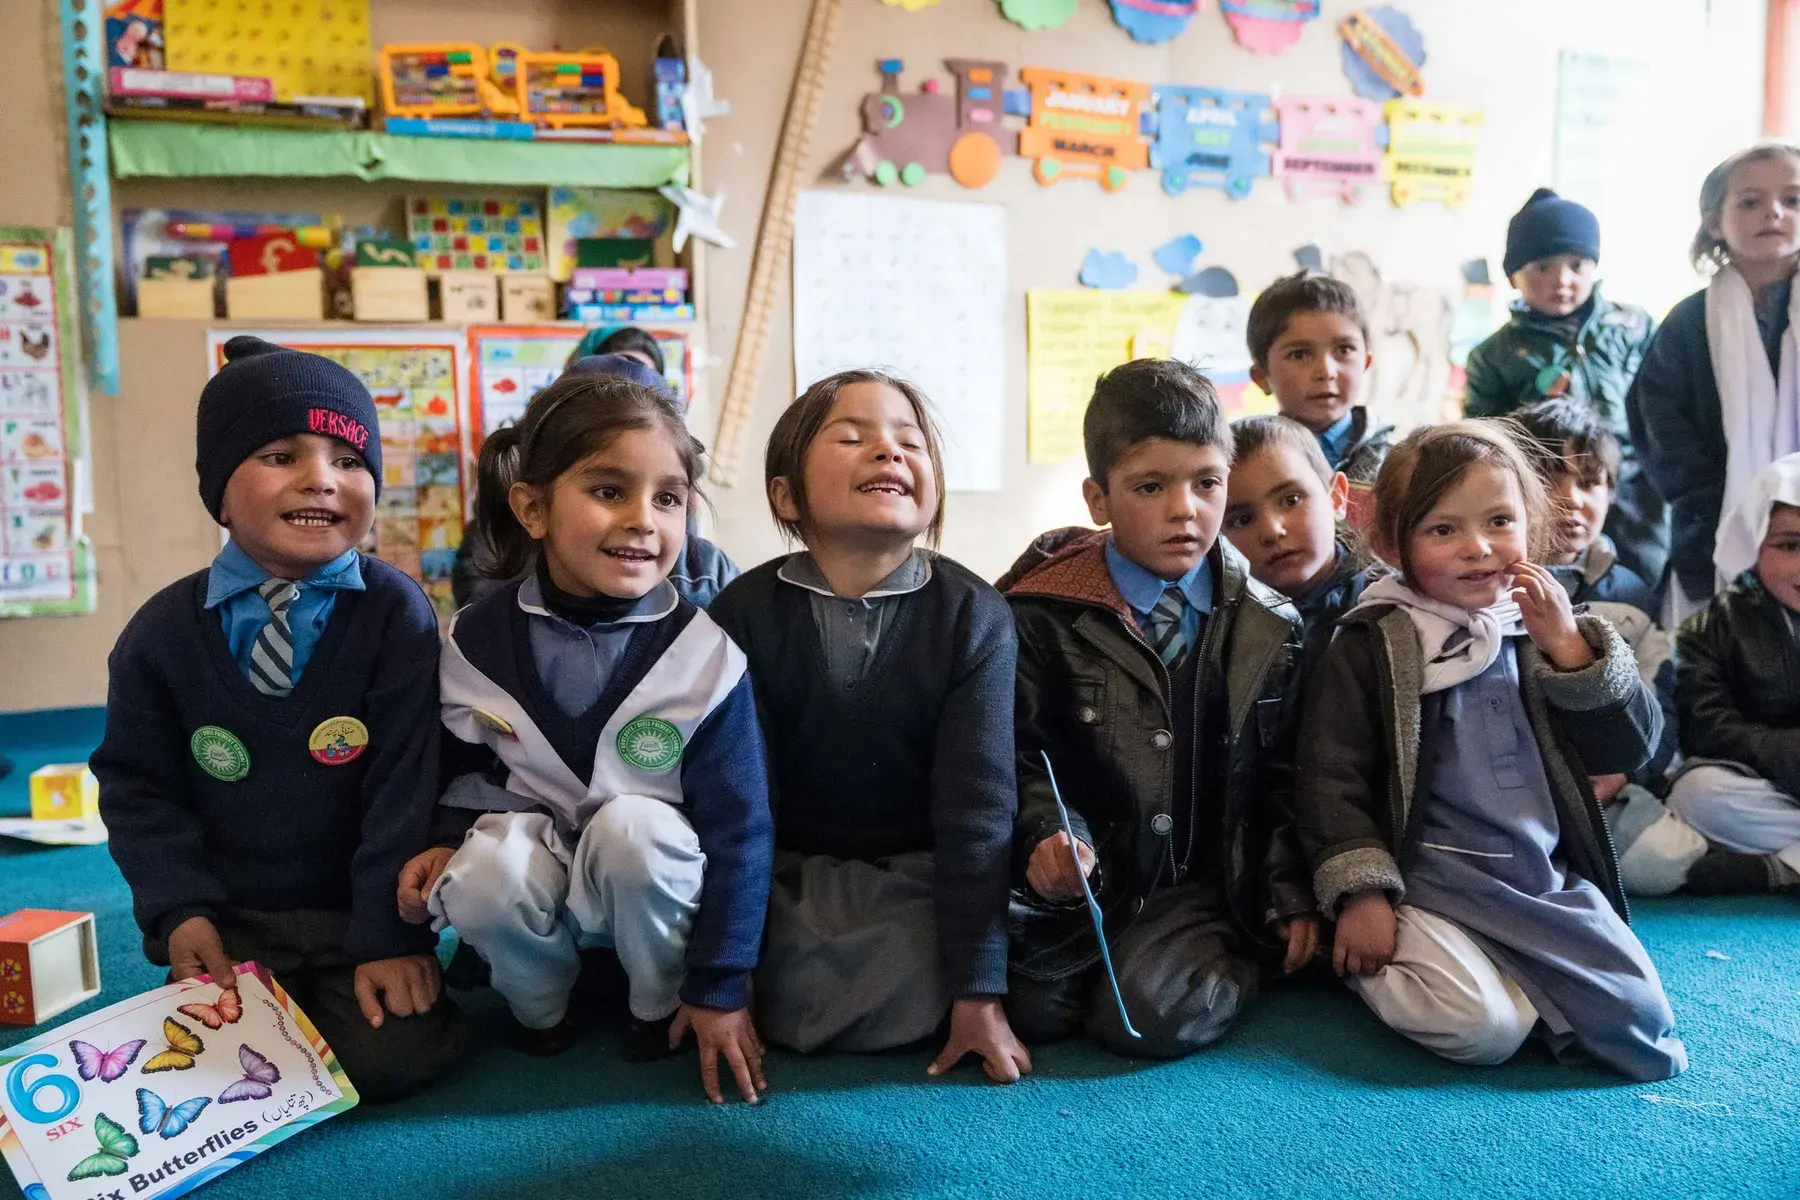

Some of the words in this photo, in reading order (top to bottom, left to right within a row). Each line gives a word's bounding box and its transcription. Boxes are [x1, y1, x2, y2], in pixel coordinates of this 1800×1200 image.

[1053, 139, 1116, 157] MARCH
[307, 408, 369, 449] VERSACE
[6, 1053, 81, 1124] 6
[46, 1117, 84, 1142] SIX
[128, 1120, 258, 1194] Butterflies
